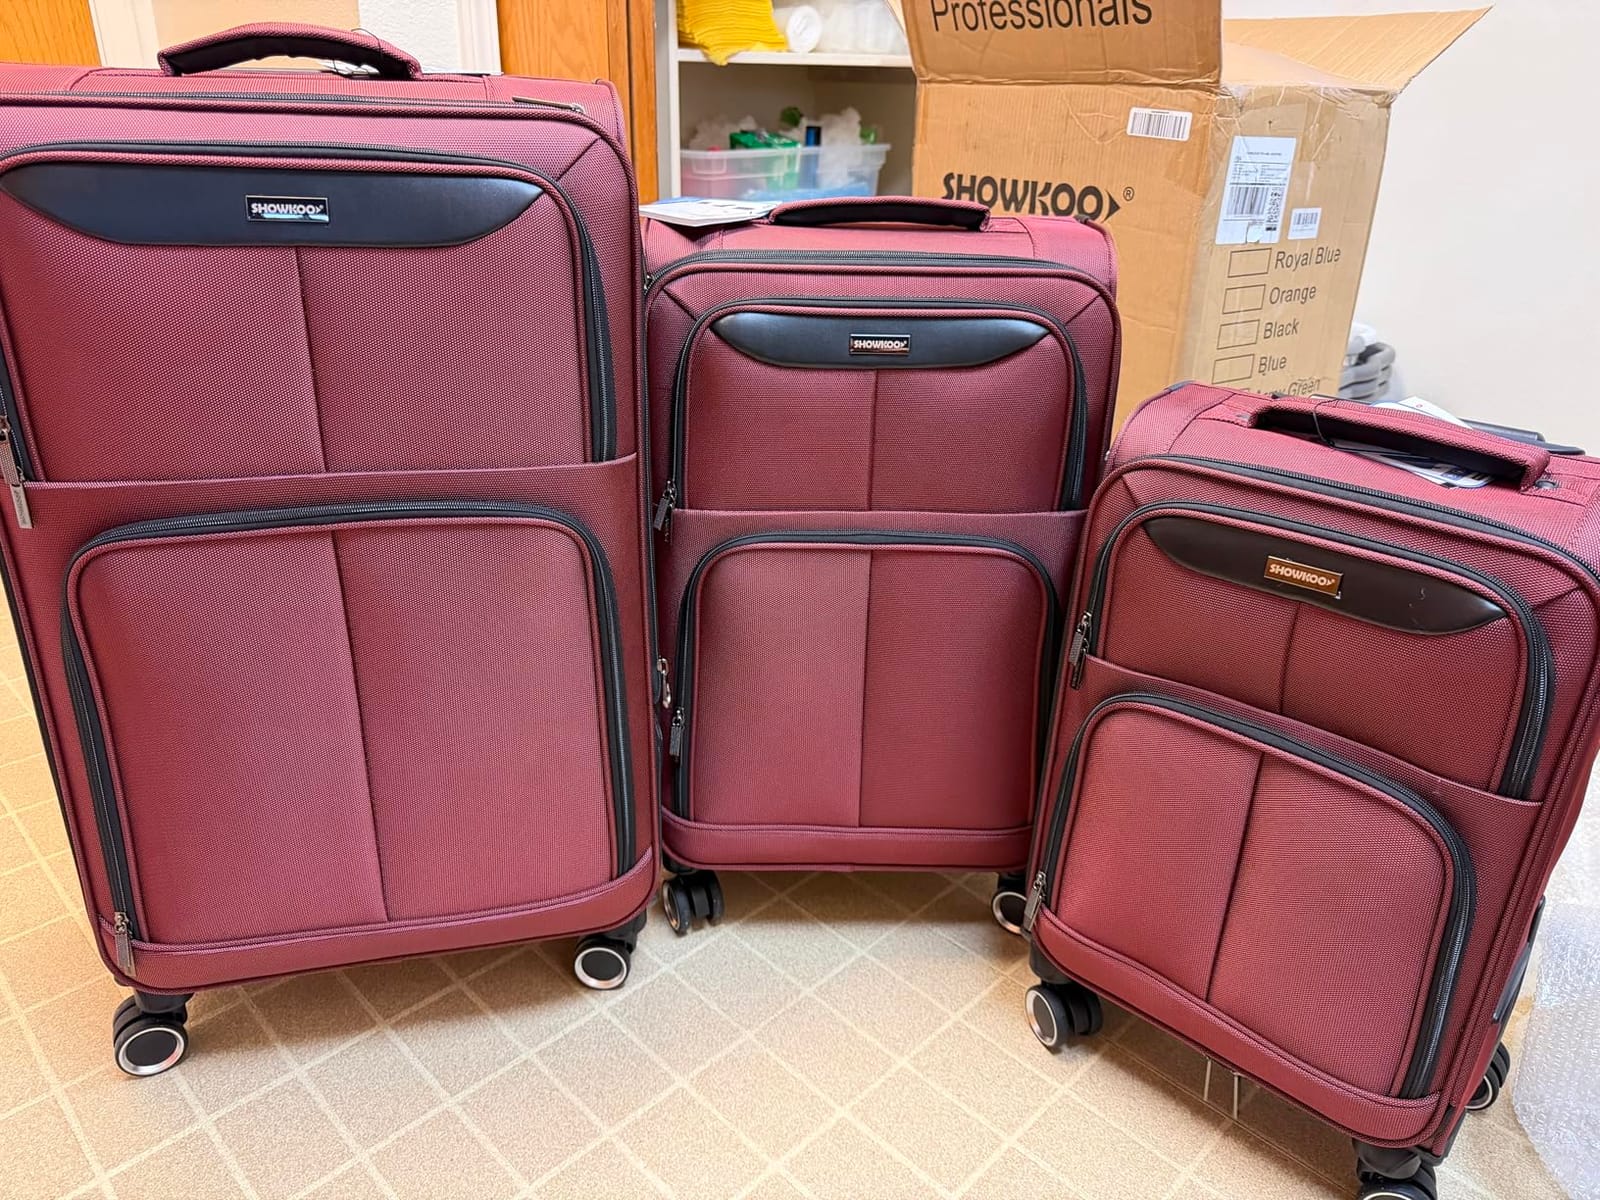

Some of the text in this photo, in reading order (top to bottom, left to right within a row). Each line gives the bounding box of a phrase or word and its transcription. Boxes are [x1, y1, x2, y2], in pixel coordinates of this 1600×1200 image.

[931, 0, 1153, 31] Professionals
[942, 172, 1104, 221] SHOWKOO
[251, 203, 315, 214] SHOWKOO
[1274, 246, 1342, 272] Royal Blue
[1269, 285, 1317, 305] Orange
[1263, 318, 1300, 339] Black
[853, 340, 901, 349] SHOWKOO
[1257, 356, 1288, 374] Blue
[1269, 563, 1327, 586] SHOWKOO
